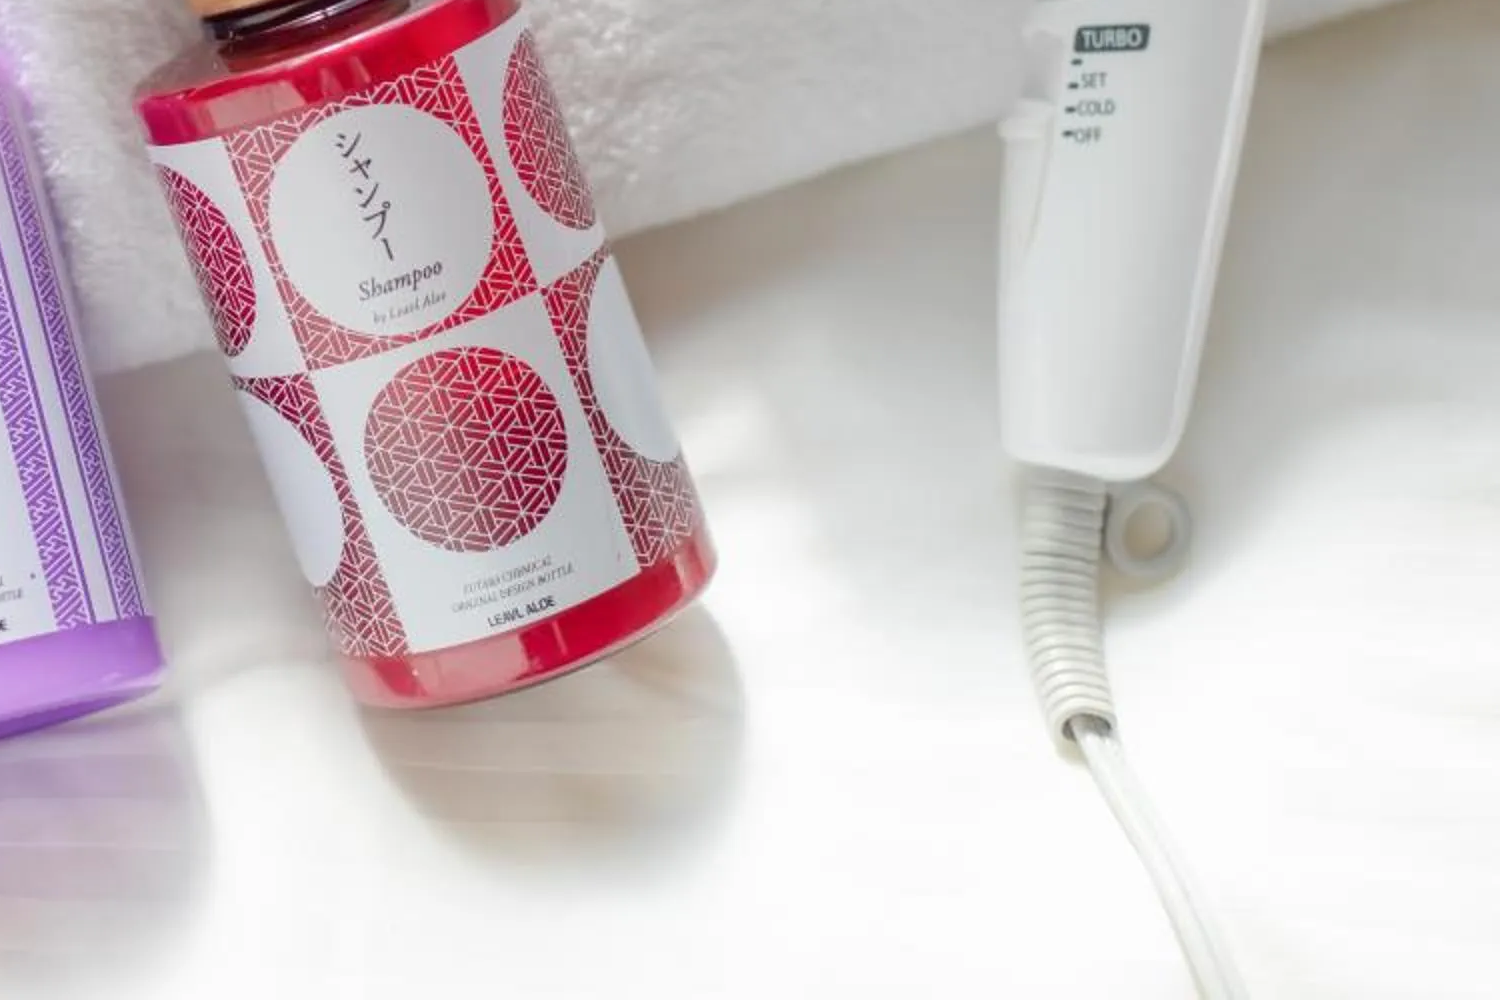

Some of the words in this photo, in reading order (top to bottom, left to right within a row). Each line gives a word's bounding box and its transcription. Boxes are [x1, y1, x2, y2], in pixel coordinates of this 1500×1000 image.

[1080, 27, 1143, 50] TURBO
[1081, 71, 1108, 89] SET
[1077, 98, 1116, 117] COLD
[1074, 126, 1102, 144] OFF
[334, 131, 394, 262] シャンプー
[359, 260, 443, 301] Shampoo
[526, 595, 557, 615] ALOE
